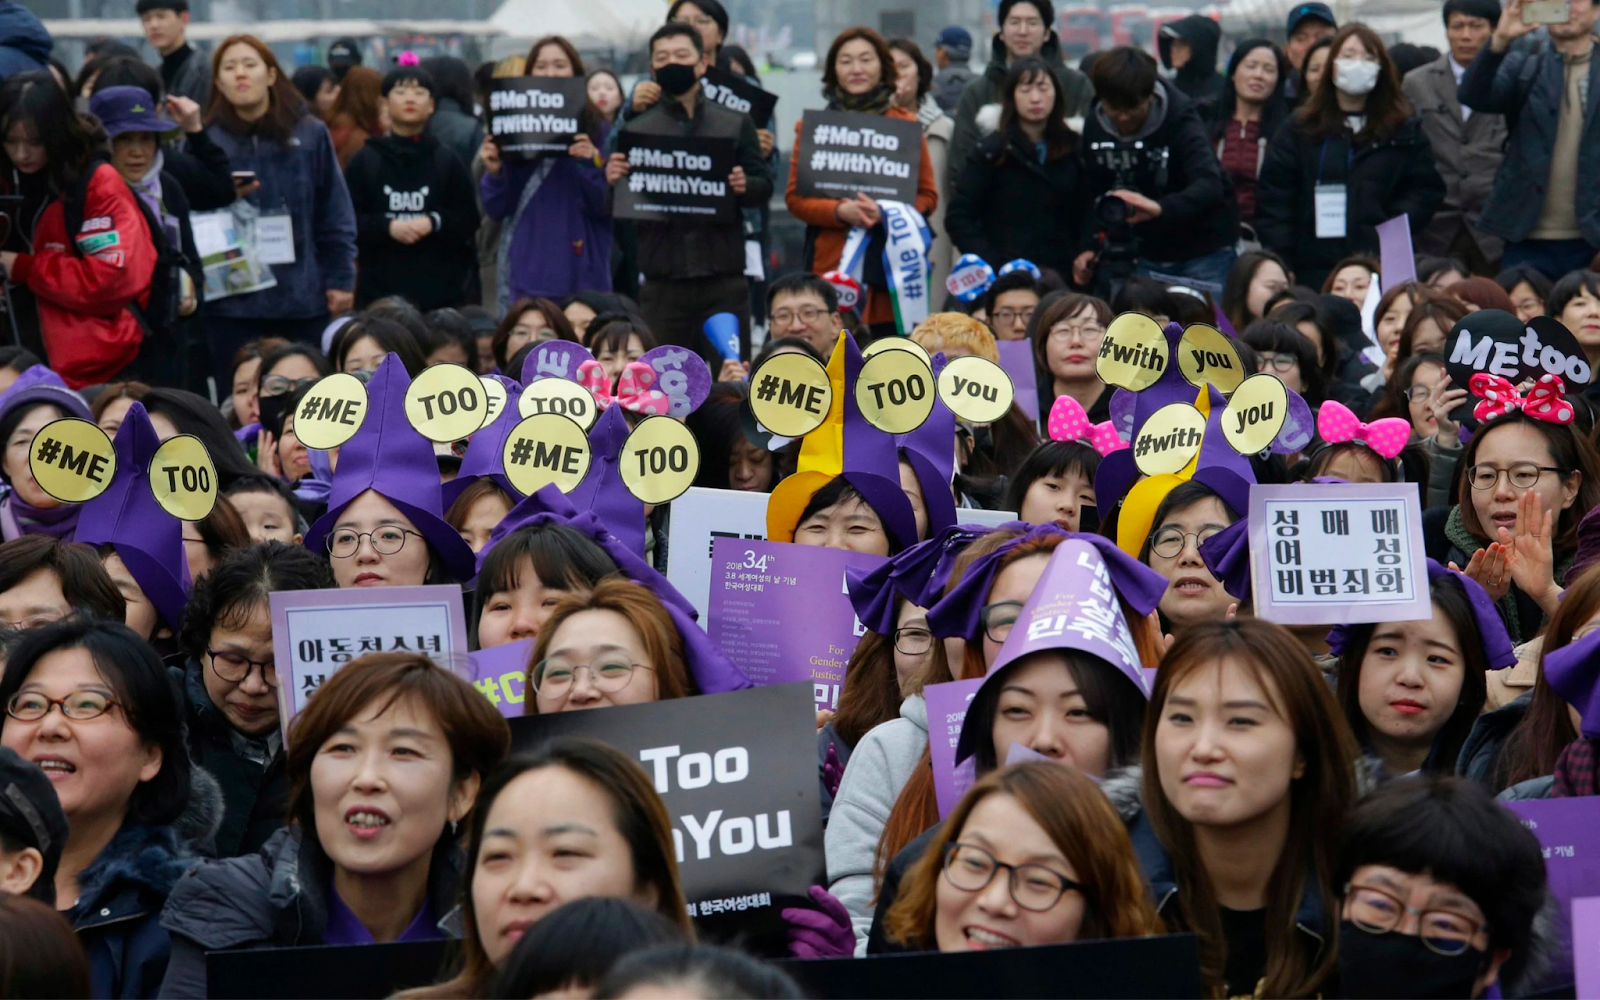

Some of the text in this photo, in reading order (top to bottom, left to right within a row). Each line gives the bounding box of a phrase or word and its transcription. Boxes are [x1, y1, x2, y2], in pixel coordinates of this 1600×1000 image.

[490, 90, 564, 111] #MeToo
[700, 77, 751, 113] eToo
[492, 114, 577, 135] #WithYou
[813, 124, 899, 151] #MeToo
[628, 147, 712, 171] #MeToo
[810, 150, 910, 178] #WithYou
[628, 172, 726, 197] #WithYou
[390, 191, 425, 211] BAD
[947, 268, 987, 294] #me
[1099, 336, 1232, 373] #with you
[757, 374, 926, 415] #ME TOO
[951, 375, 999, 403] you
[300, 387, 478, 426] #ME TOO
[1136, 427, 1202, 457] #with
[1235, 401, 1274, 434] you
[37, 437, 210, 493] #ME TOO
[510, 437, 688, 477] #ME TOO
[724, 582, 764, 593] 한국여성대회
[774, 575, 781, 584] 날
[783, 577, 797, 586] 기념
[1276, 568, 1405, 595] 비범죄화
[809, 656, 843, 668] Gender
[828, 644, 845, 656] For
[810, 669, 842, 681] Justice
[1555, 845, 1575, 858] 기념
[699, 892, 772, 916] 한국여성대회
